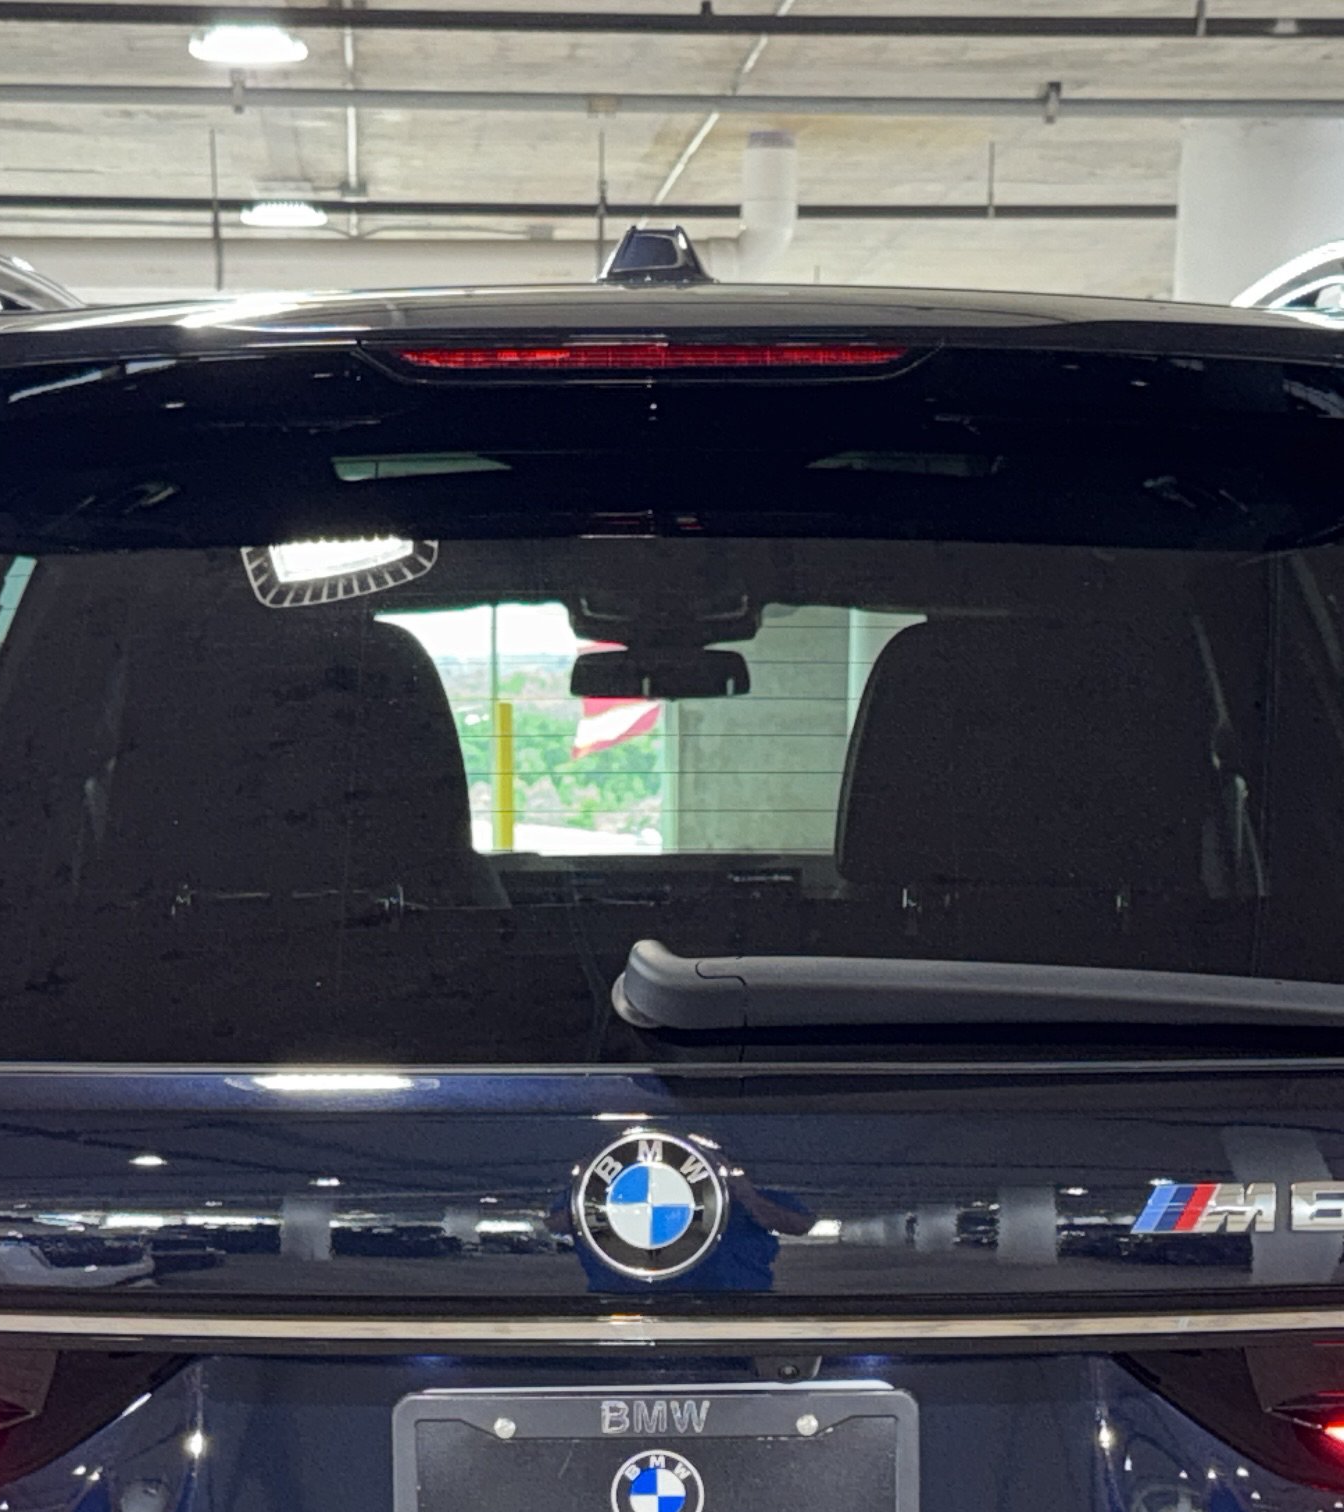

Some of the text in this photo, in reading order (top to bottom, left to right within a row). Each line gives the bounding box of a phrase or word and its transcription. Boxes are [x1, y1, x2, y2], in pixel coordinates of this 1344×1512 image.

[594, 1139, 709, 1184] BMW
[601, 1400, 710, 1433] BMW
[624, 1454, 692, 1481] BMW
